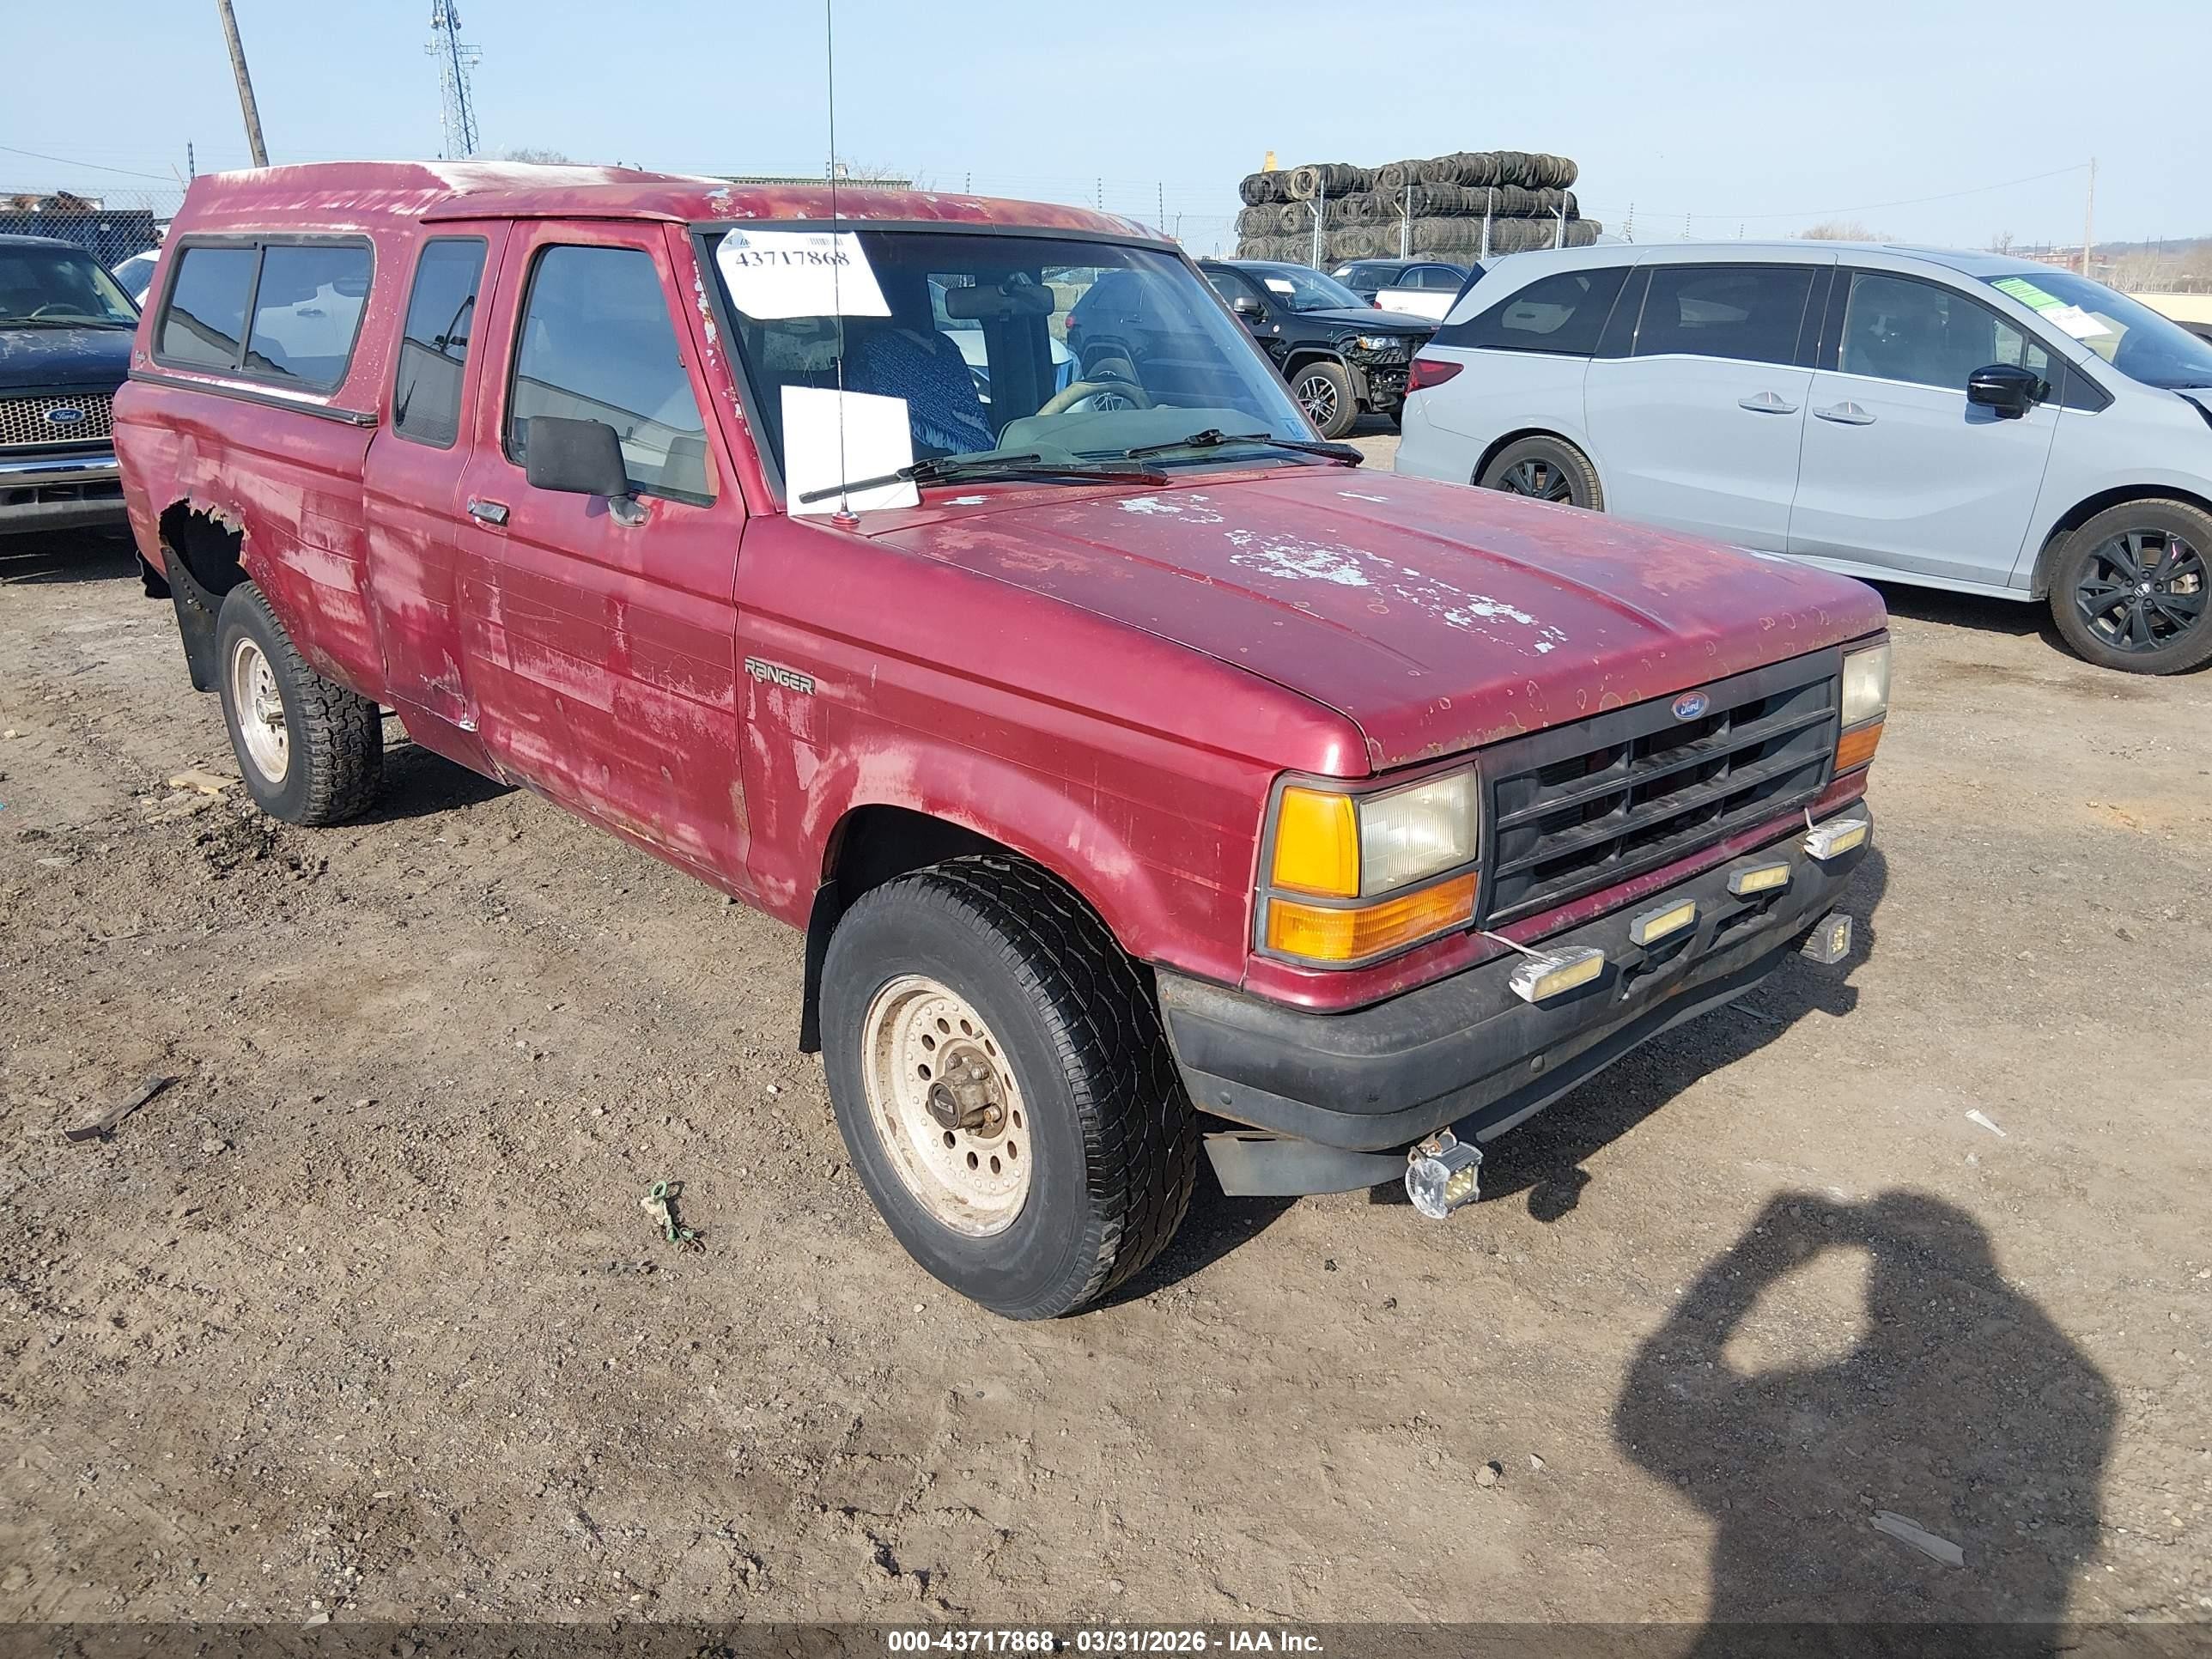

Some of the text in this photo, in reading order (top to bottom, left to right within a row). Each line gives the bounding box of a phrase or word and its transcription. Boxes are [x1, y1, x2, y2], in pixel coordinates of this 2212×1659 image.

[735, 251, 850, 267] 43717868
[55, 410, 76, 421] Ford
[744, 658, 815, 696] RANGER
